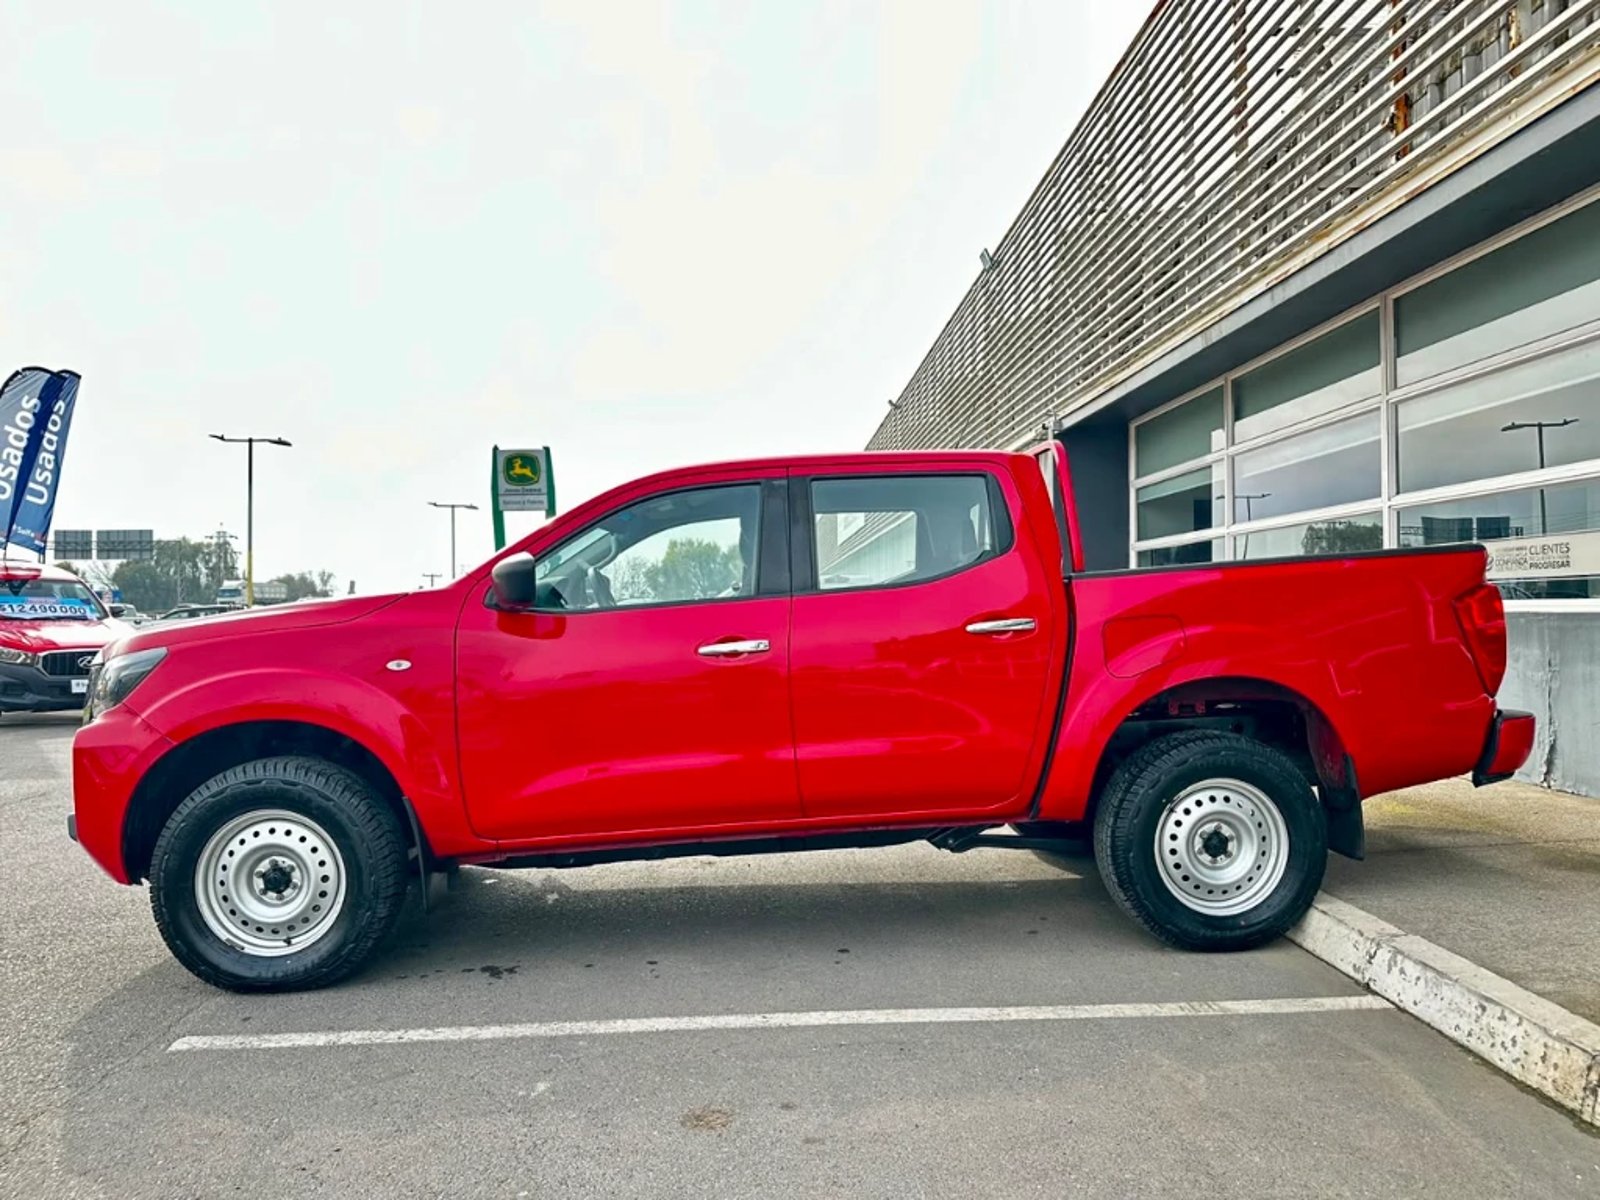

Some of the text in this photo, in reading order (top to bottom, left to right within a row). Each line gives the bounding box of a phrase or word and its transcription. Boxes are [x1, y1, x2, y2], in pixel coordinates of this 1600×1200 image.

[26, 400, 65, 506] Usados
[1529, 542, 1570, 556] CLIENTES
[1529, 560, 1571, 570] PROGRESAR
